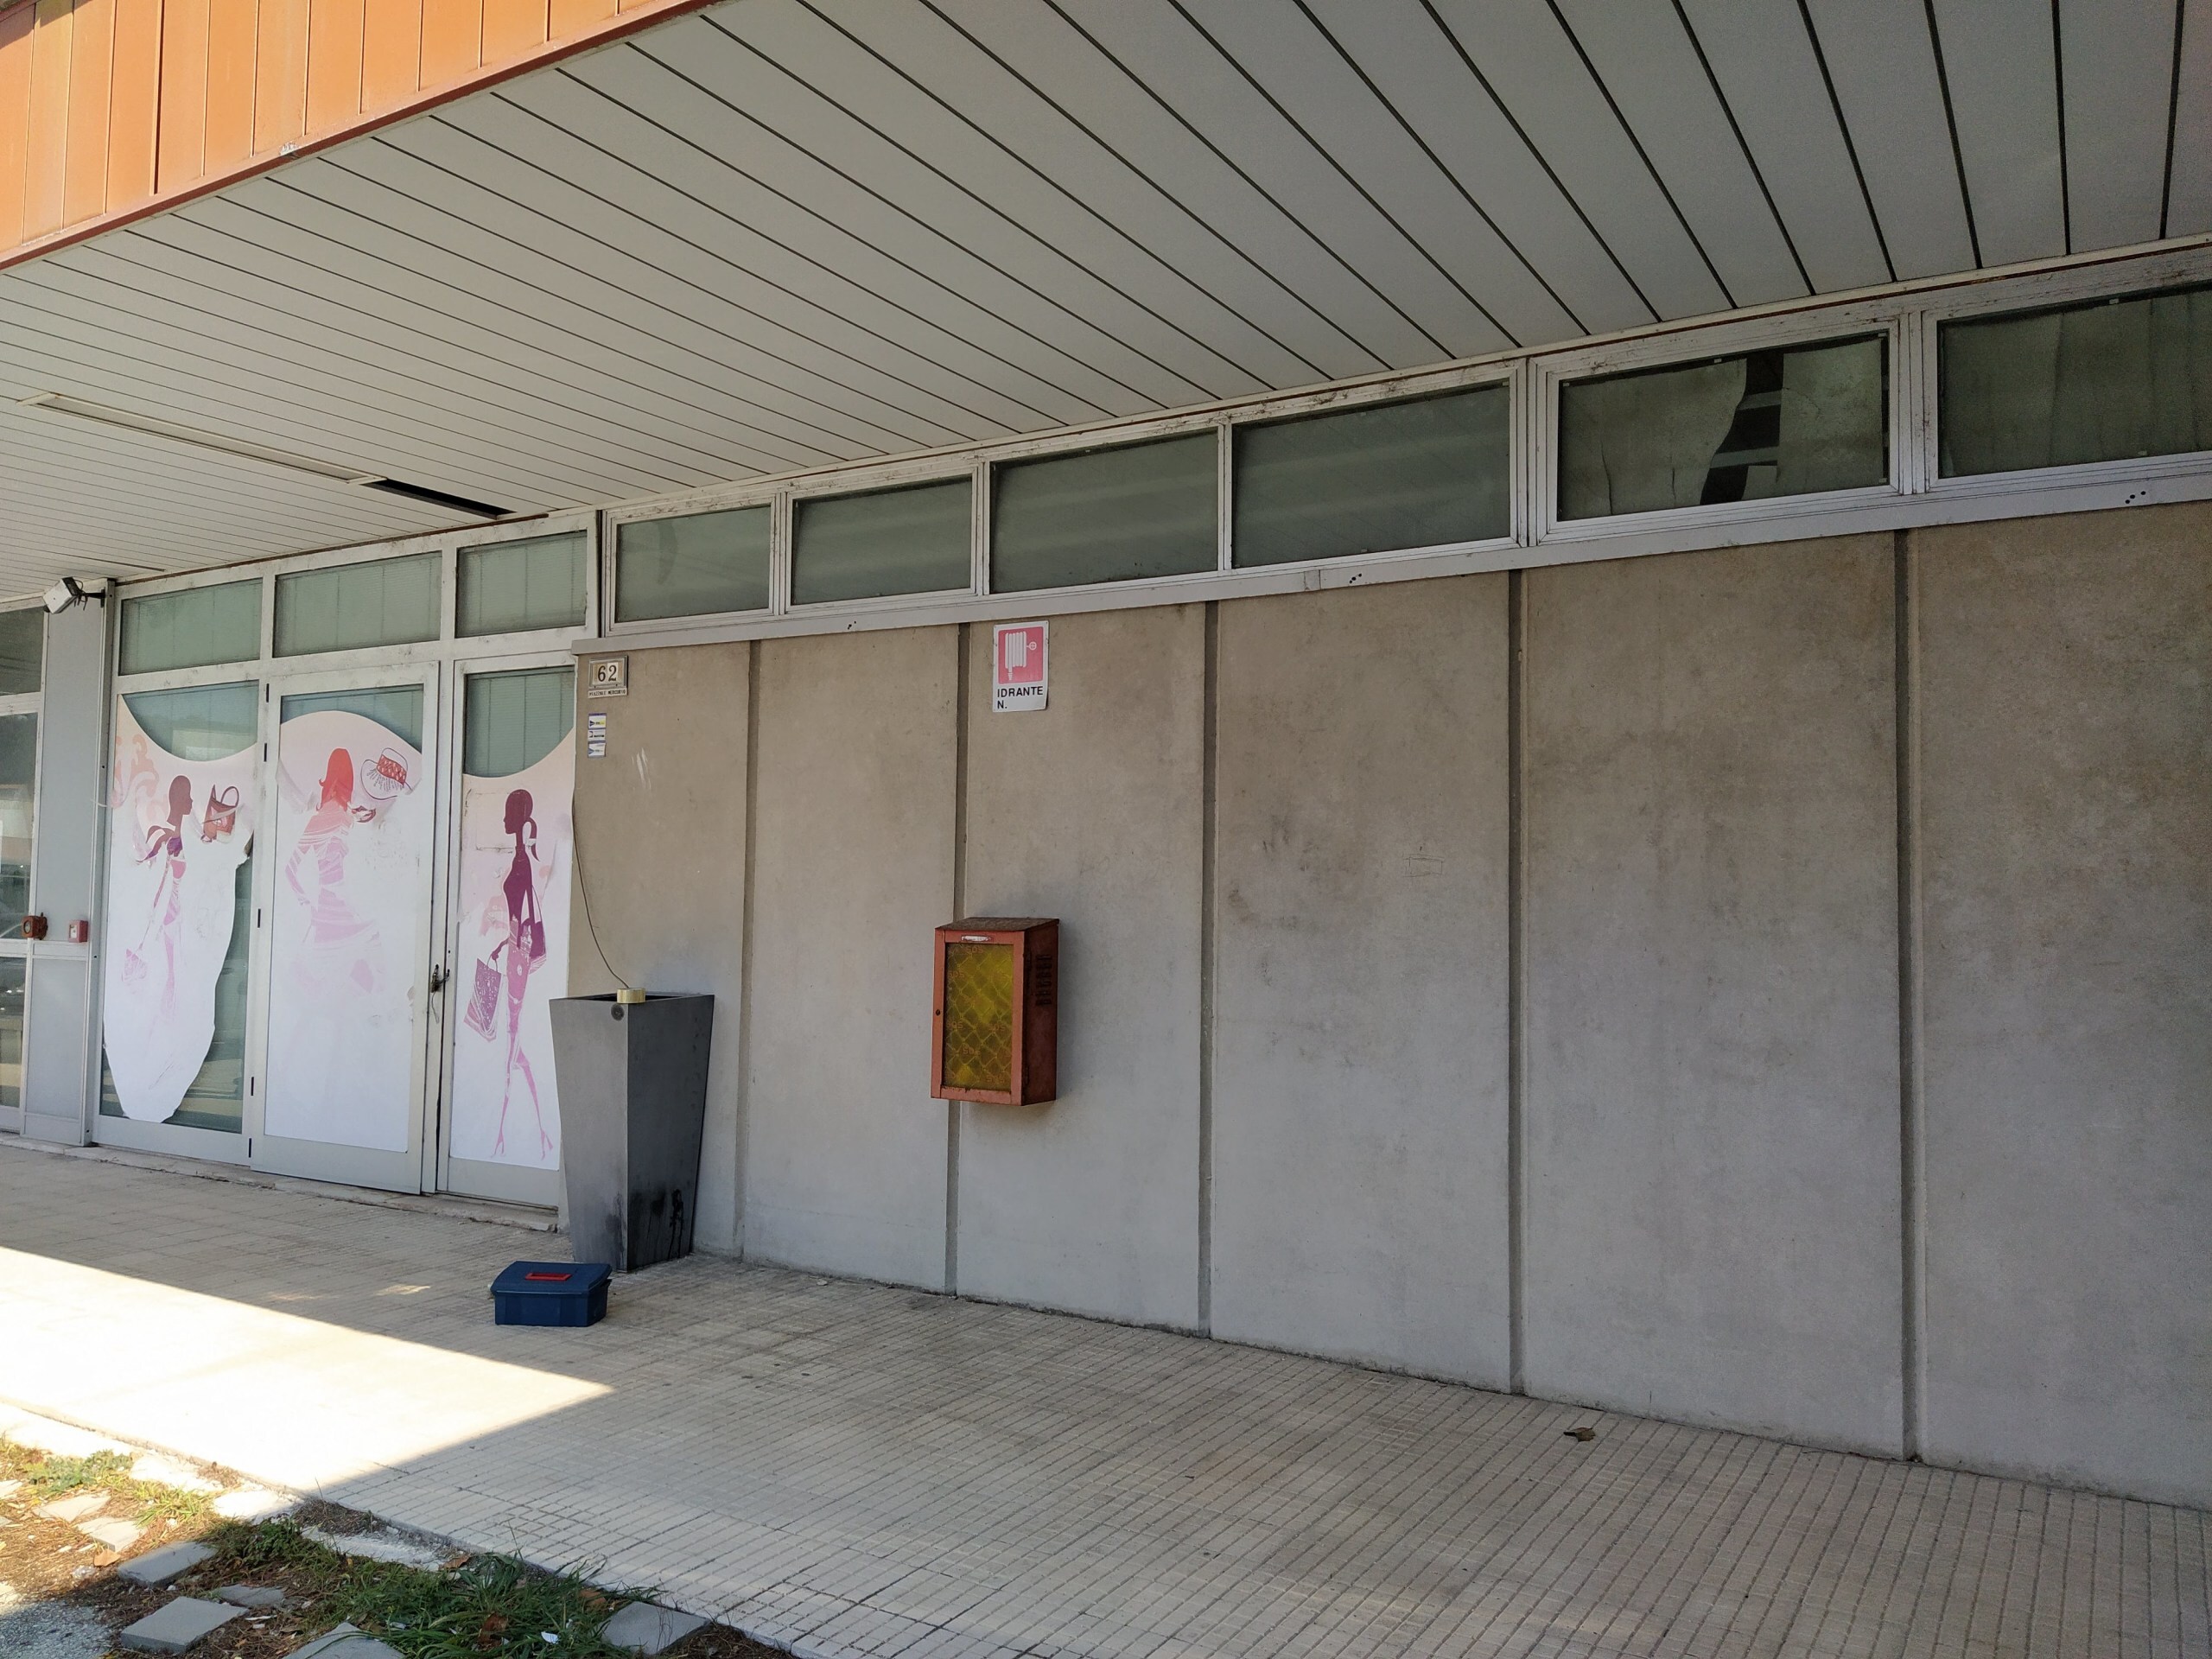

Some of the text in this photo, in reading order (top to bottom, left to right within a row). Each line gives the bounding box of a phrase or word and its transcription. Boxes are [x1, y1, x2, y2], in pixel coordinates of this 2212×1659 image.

[598, 665, 617, 682] 62
[997, 686, 1043, 697] IDRANTE
[997, 700, 1007, 709] N.
